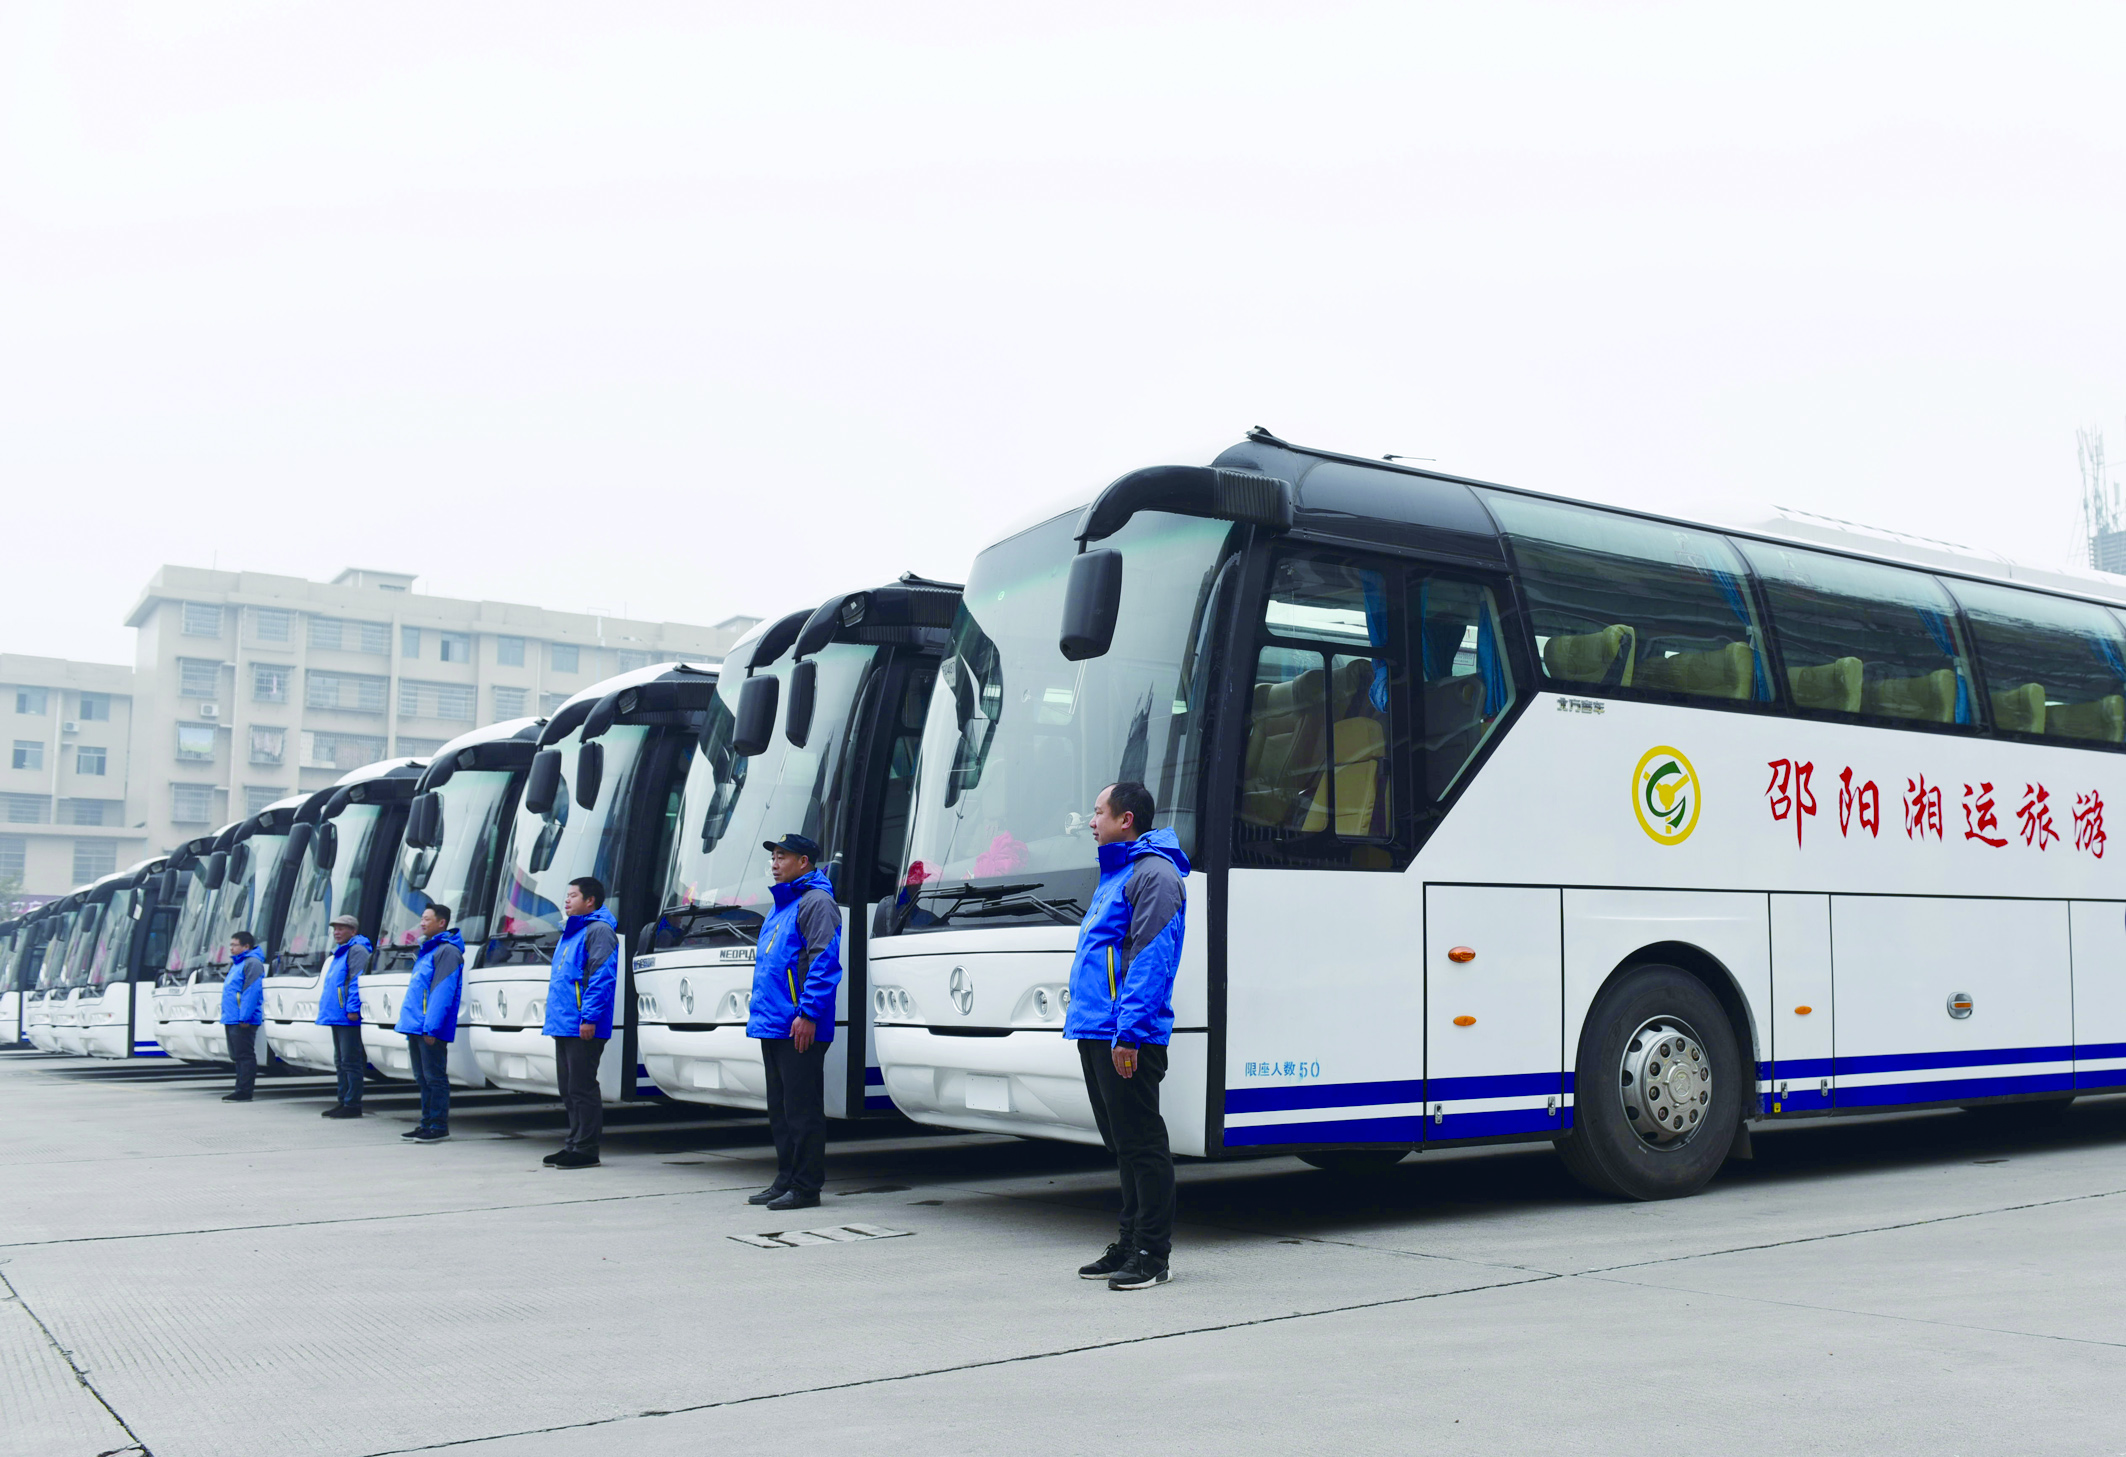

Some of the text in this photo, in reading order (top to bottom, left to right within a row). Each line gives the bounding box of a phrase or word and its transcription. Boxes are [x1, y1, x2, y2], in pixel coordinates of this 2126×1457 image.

[1764, 758, 2107, 859] 邵阳湘运旅游
[719, 948, 757, 962] NEOPLA
